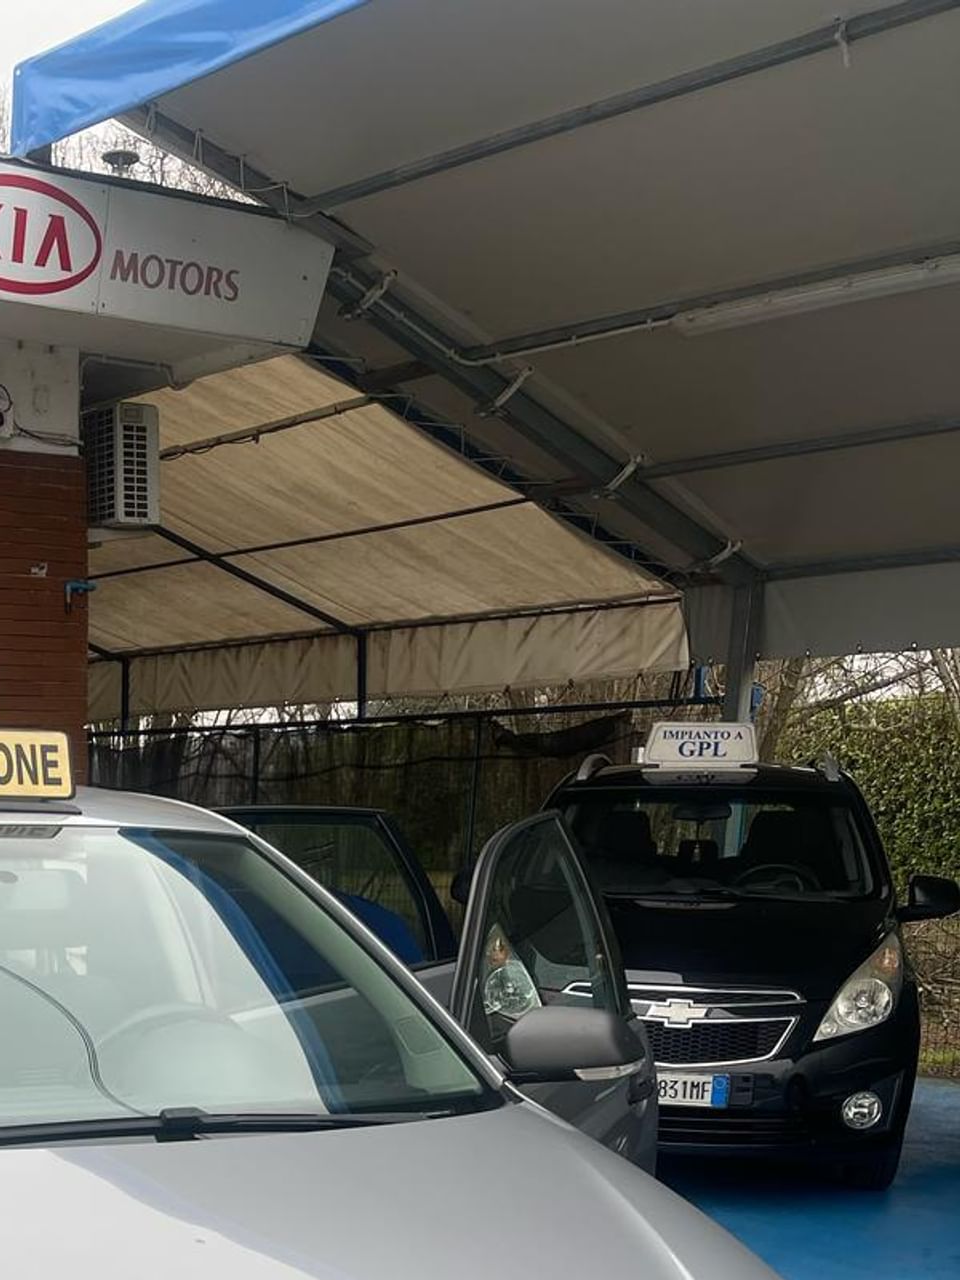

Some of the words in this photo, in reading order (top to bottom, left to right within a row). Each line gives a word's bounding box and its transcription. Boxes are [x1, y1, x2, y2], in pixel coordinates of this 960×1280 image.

[110, 250, 240, 301] MOTORS
[662, 730, 731, 740] IMPIANTO
[734, 730, 743, 740] A
[678, 740, 727, 758] GPL
[658, 1079, 712, 1101] 831MF
